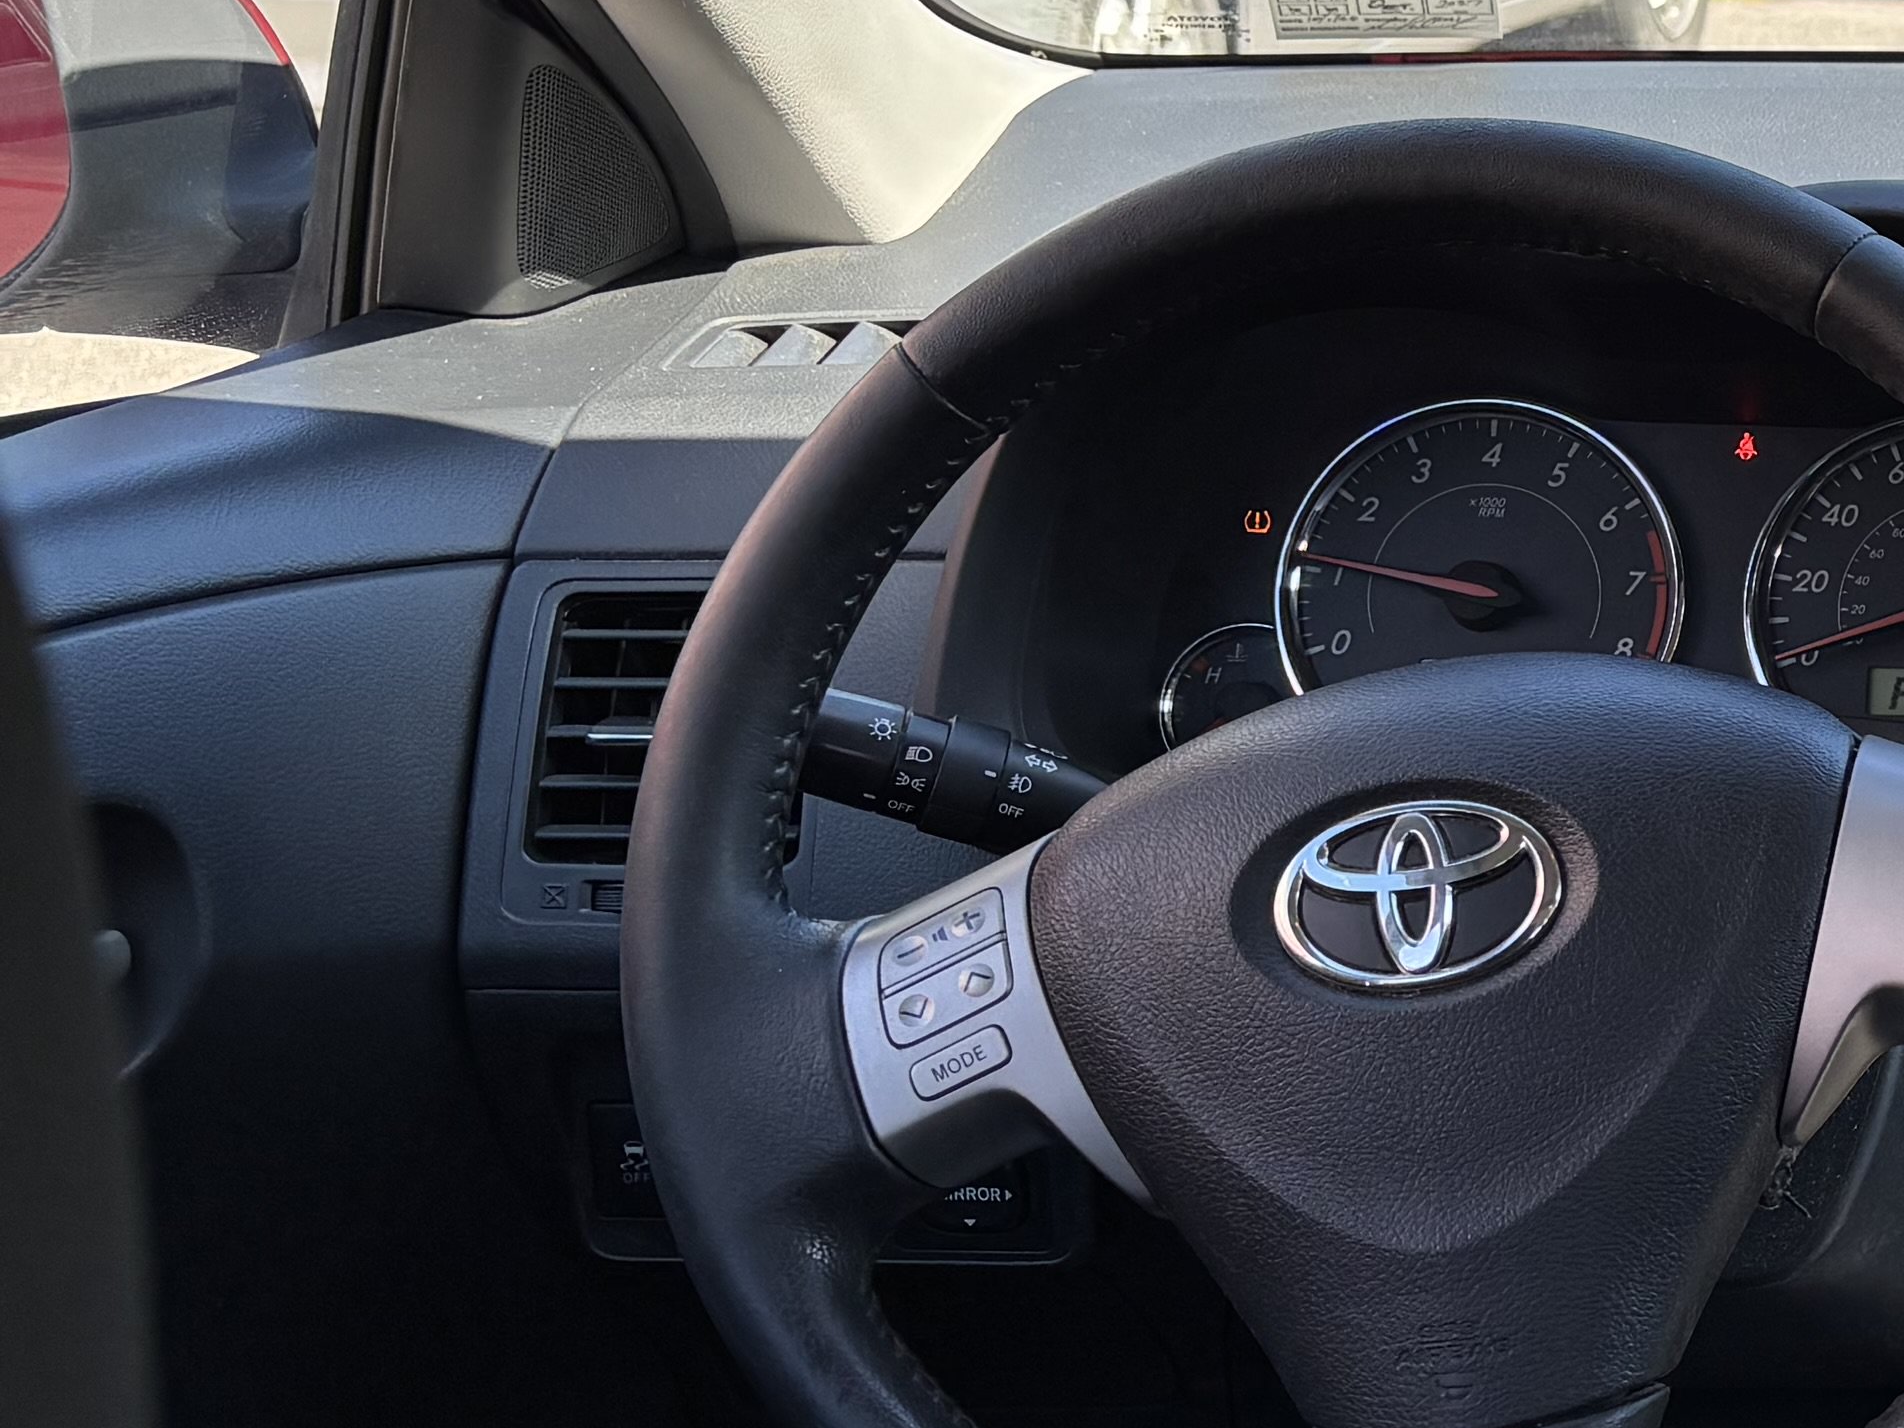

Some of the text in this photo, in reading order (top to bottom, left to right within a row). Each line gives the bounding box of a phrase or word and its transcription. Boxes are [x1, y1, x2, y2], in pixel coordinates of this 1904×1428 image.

[1481, 442, 1503, 468] 4
[1411, 458, 1432, 484] 3
[1547, 462, 1568, 488] 5
[1356, 496, 1380, 523] 2
[1478, 507, 1506, 519] RPM
[1598, 506, 1620, 533] 6
[1821, 503, 1859, 527] 40
[1868, 548, 1885, 559] 60
[1624, 570, 1646, 596] 7
[1791, 569, 1830, 593] 20
[1853, 575, 1870, 586] 40
[1849, 603, 1866, 615] 20
[1330, 628, 1352, 655] 0
[1612, 637, 1634, 658] 8
[1800, 648, 1820, 667] 0
[1205, 666, 1222, 684] H
[888, 799, 915, 814] OFF
[998, 802, 1024, 818] OFF
[930, 1044, 988, 1085] MODE
[623, 1172, 650, 1185] OFF
